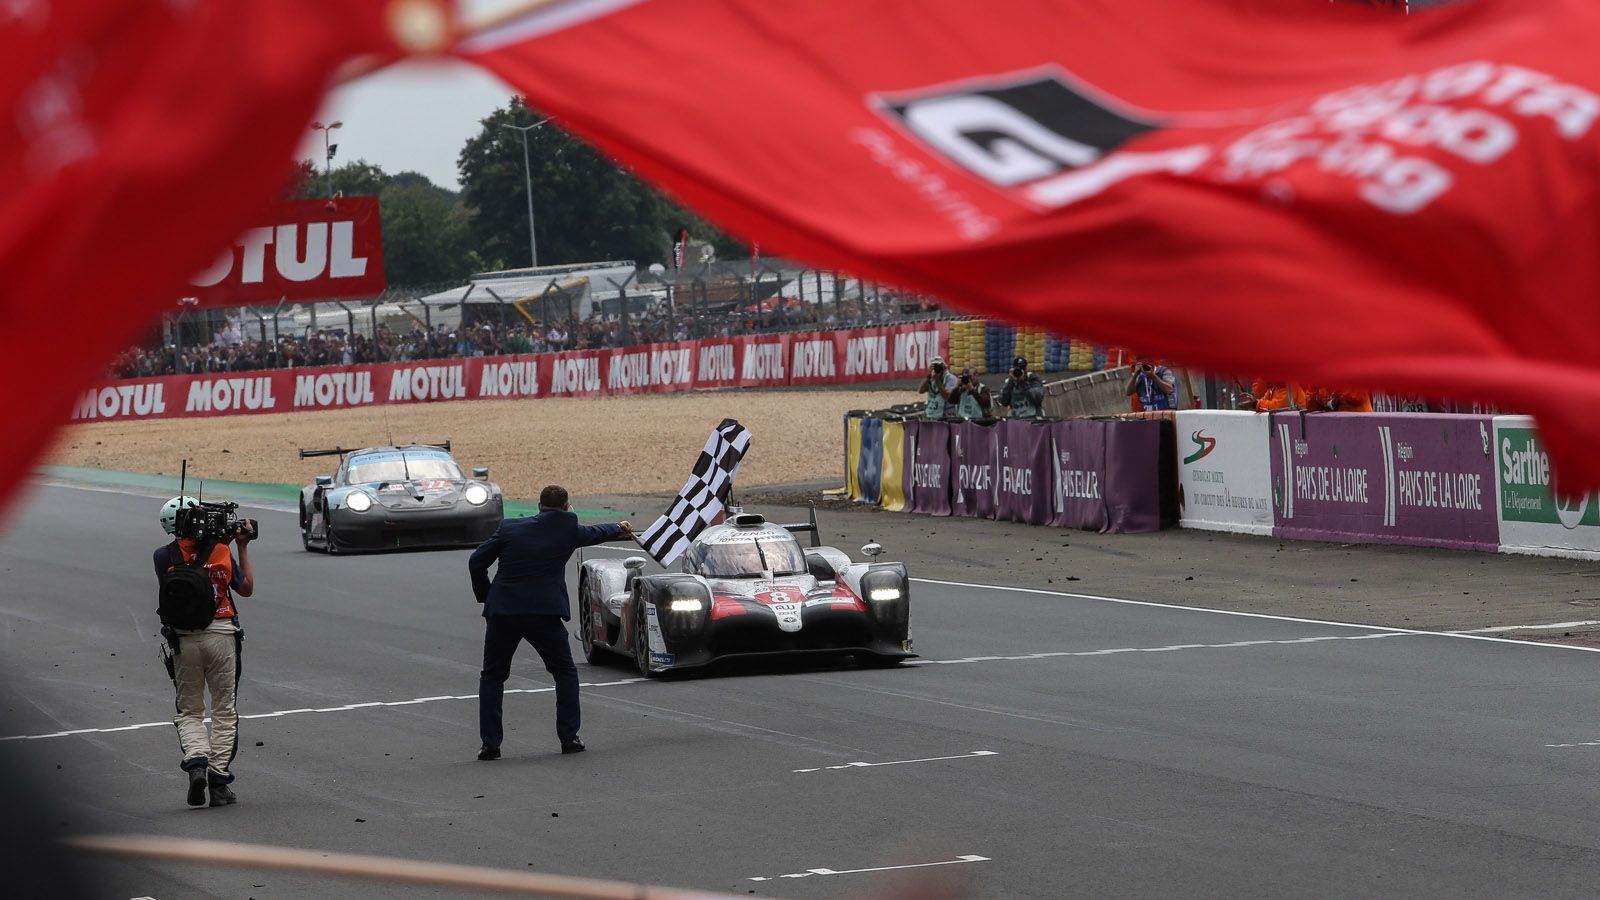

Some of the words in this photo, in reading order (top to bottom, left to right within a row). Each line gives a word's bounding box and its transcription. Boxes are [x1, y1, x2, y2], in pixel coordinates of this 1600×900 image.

[186, 220, 368, 288] OTUL
[608, 352, 650, 389] MOTUL
[651, 349, 692, 386] MOTUL
[698, 343, 736, 381] MOTUL
[742, 342, 785, 380] MOTUL
[793, 340, 836, 378] MOTUL
[845, 335, 889, 375] MOTUL
[294, 371, 374, 408] MOTUL
[389, 365, 466, 401] MOTUL
[479, 361, 539, 396] MOTUL
[551, 357, 601, 392] MOTUL
[71, 383, 166, 420] MOTUL
[185, 376, 276, 412] MOTUL
[1295, 439, 1309, 459] Région
[1397, 442, 1414, 462] Région
[1502, 437, 1550, 486] Sarthe
[1224, 487, 1231, 507] 24
[1296, 465, 1317, 500] PAYS
[1318, 466, 1330, 501] DE
[1331, 467, 1343, 502] LA
[1344, 467, 1368, 503] LOIRE
[1399, 470, 1422, 507] PAYS
[1424, 471, 1437, 508] DE
[1439, 472, 1452, 509] LA
[1453, 473, 1482, 510] LOIRE
[1504, 490, 1511, 509] Le
[1511, 490, 1542, 514] Département
[770, 591, 791, 603] 8
